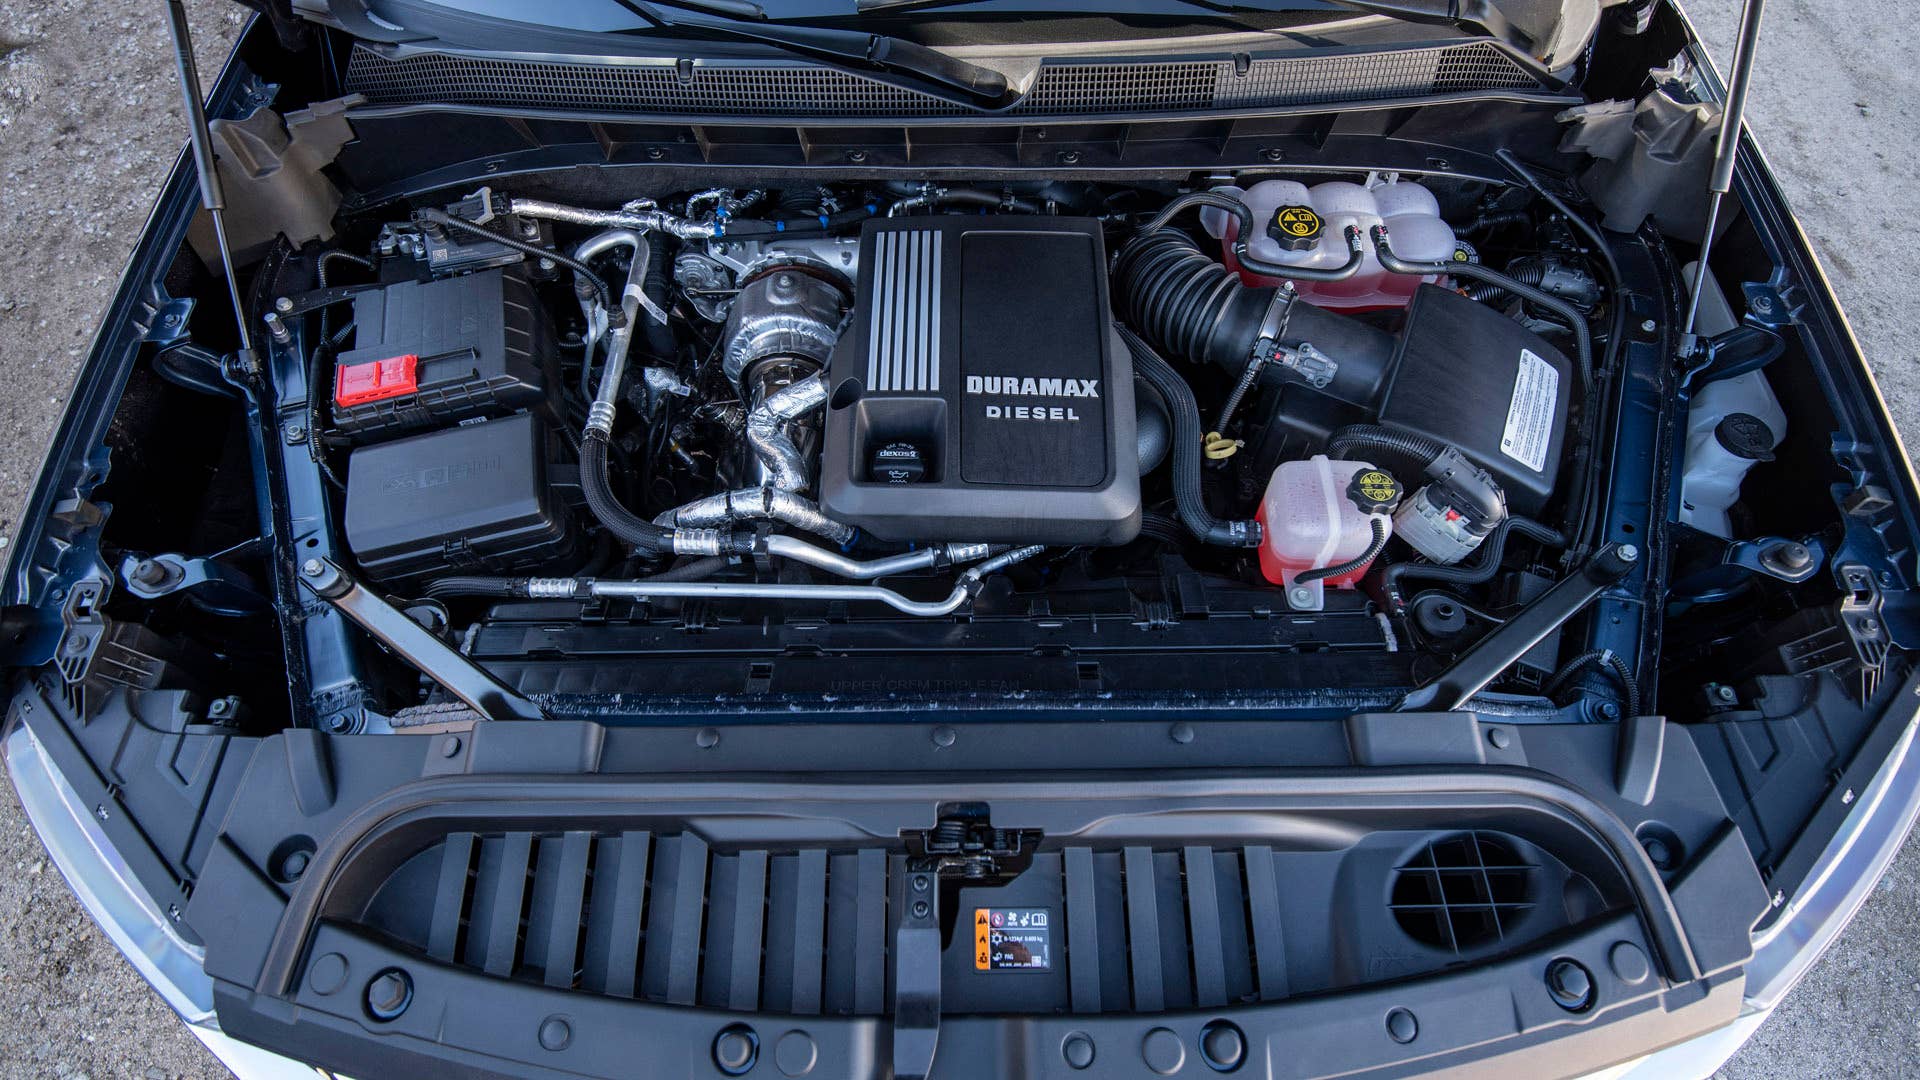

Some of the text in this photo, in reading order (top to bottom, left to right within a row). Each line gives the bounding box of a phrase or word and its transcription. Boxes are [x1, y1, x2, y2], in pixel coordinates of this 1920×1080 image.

[966, 375, 1099, 398] DURAMAX
[986, 405, 1080, 420] DIESEL
[831, 679, 881, 691] UPPER
[934, 679, 986, 691] TRIPLE
